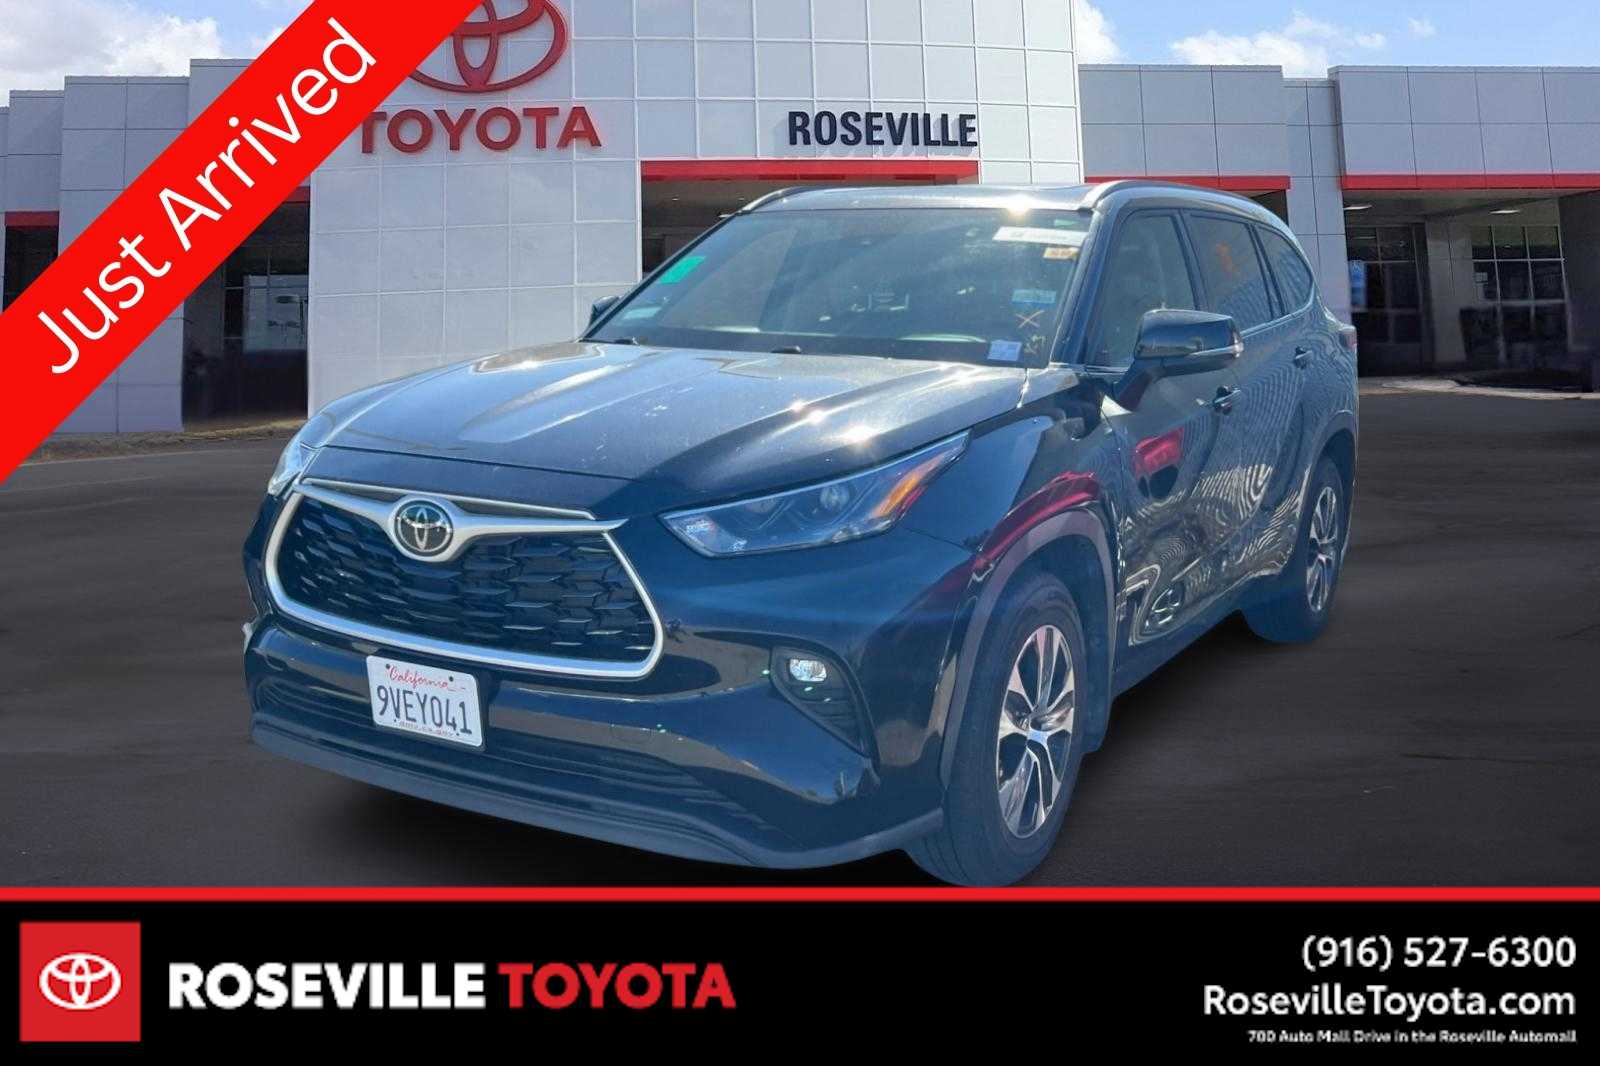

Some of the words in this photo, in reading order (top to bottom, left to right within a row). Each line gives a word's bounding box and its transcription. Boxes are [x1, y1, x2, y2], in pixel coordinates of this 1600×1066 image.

[361, 106, 602, 154] TOYOTA
[788, 111, 978, 147] ROSEVILLE
[389, 664, 449, 690] California
[376, 684, 473, 735] 9VEY041
